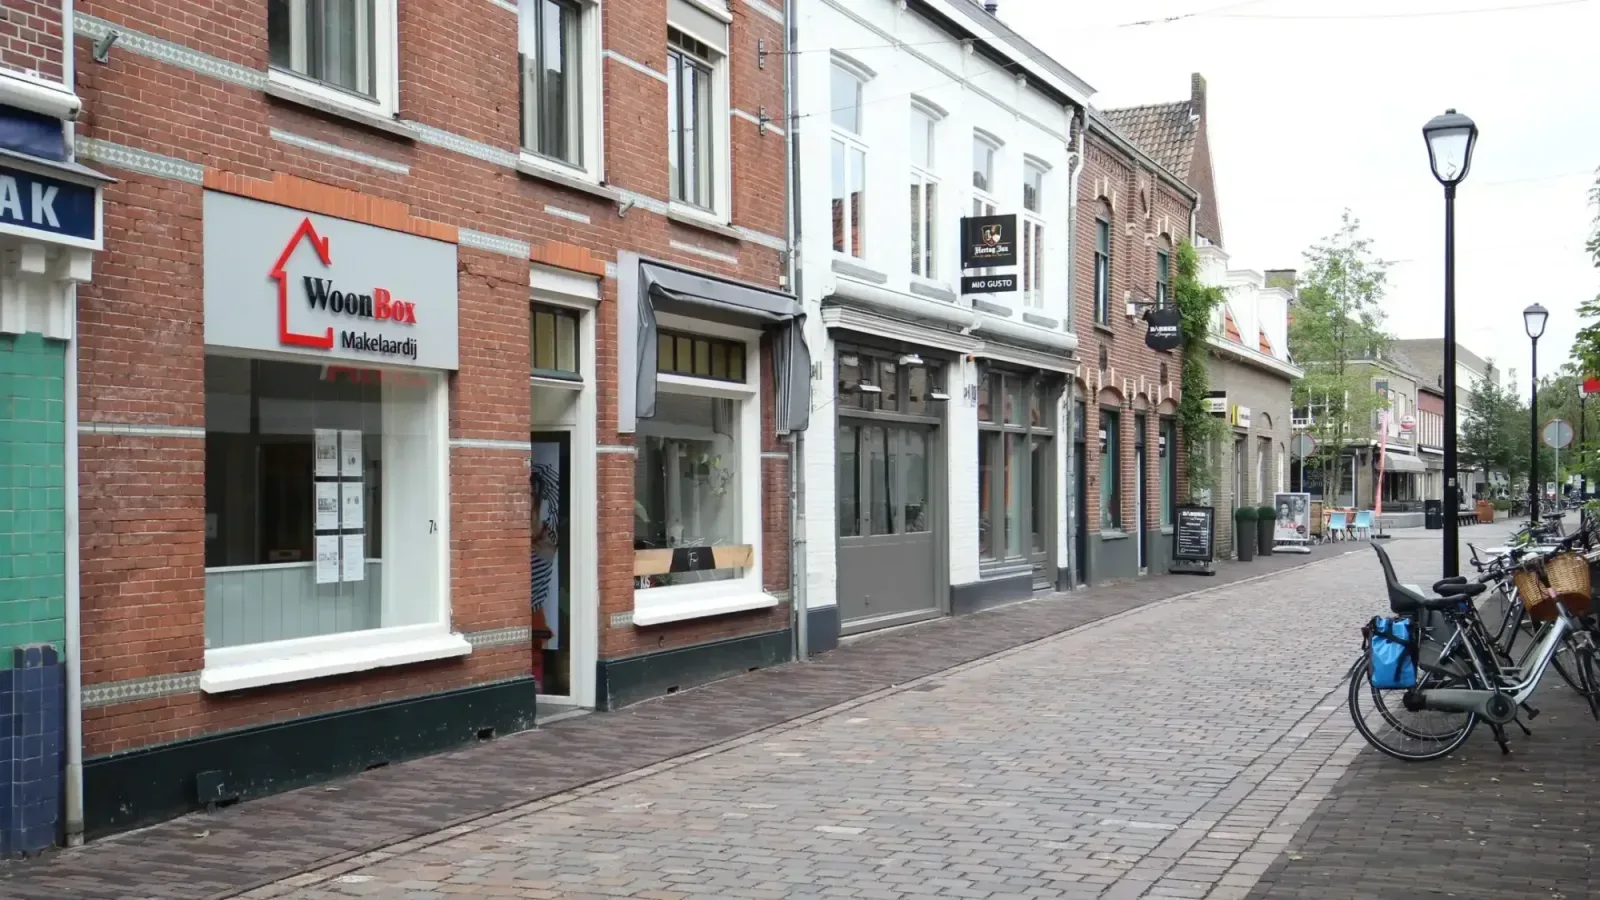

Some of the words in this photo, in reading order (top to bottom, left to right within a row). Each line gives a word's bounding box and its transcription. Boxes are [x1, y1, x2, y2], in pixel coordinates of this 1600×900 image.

[971, 281, 986, 289] MIO
[987, 279, 1013, 288] GUSTO
[303, 275, 417, 324] WoonBox
[342, 331, 417, 360] Makelaardij
